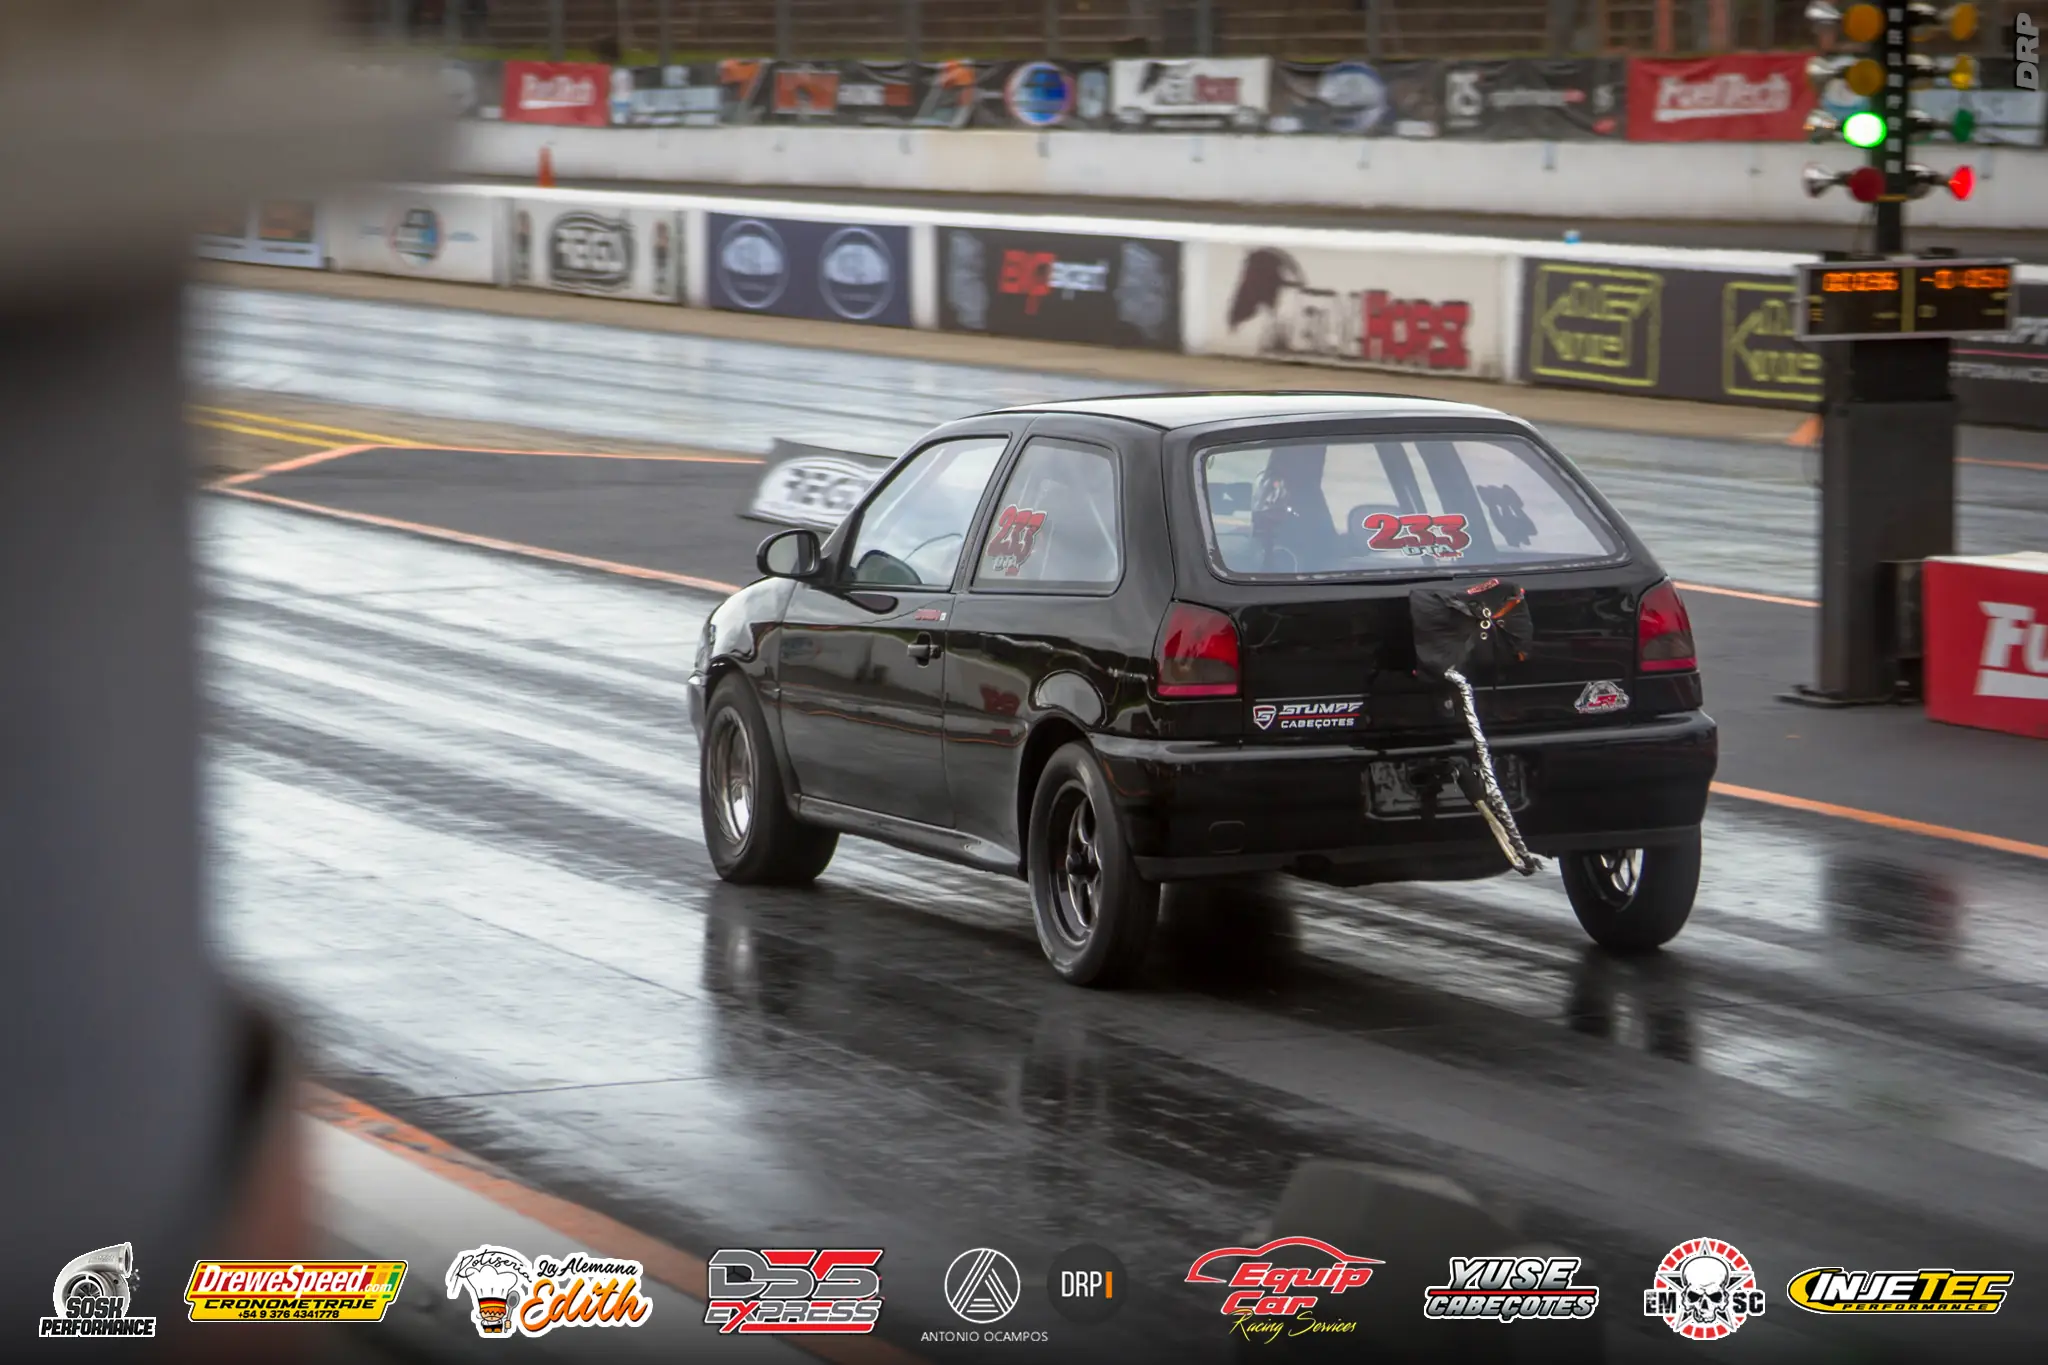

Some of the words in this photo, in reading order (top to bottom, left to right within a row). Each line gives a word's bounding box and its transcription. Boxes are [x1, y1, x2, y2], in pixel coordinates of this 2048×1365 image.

[985, 504, 1047, 566] 233
[1362, 513, 1472, 550] 233
[1279, 702, 1363, 715] STUMPF
[1281, 718, 1355, 729] CABEÇOTES
